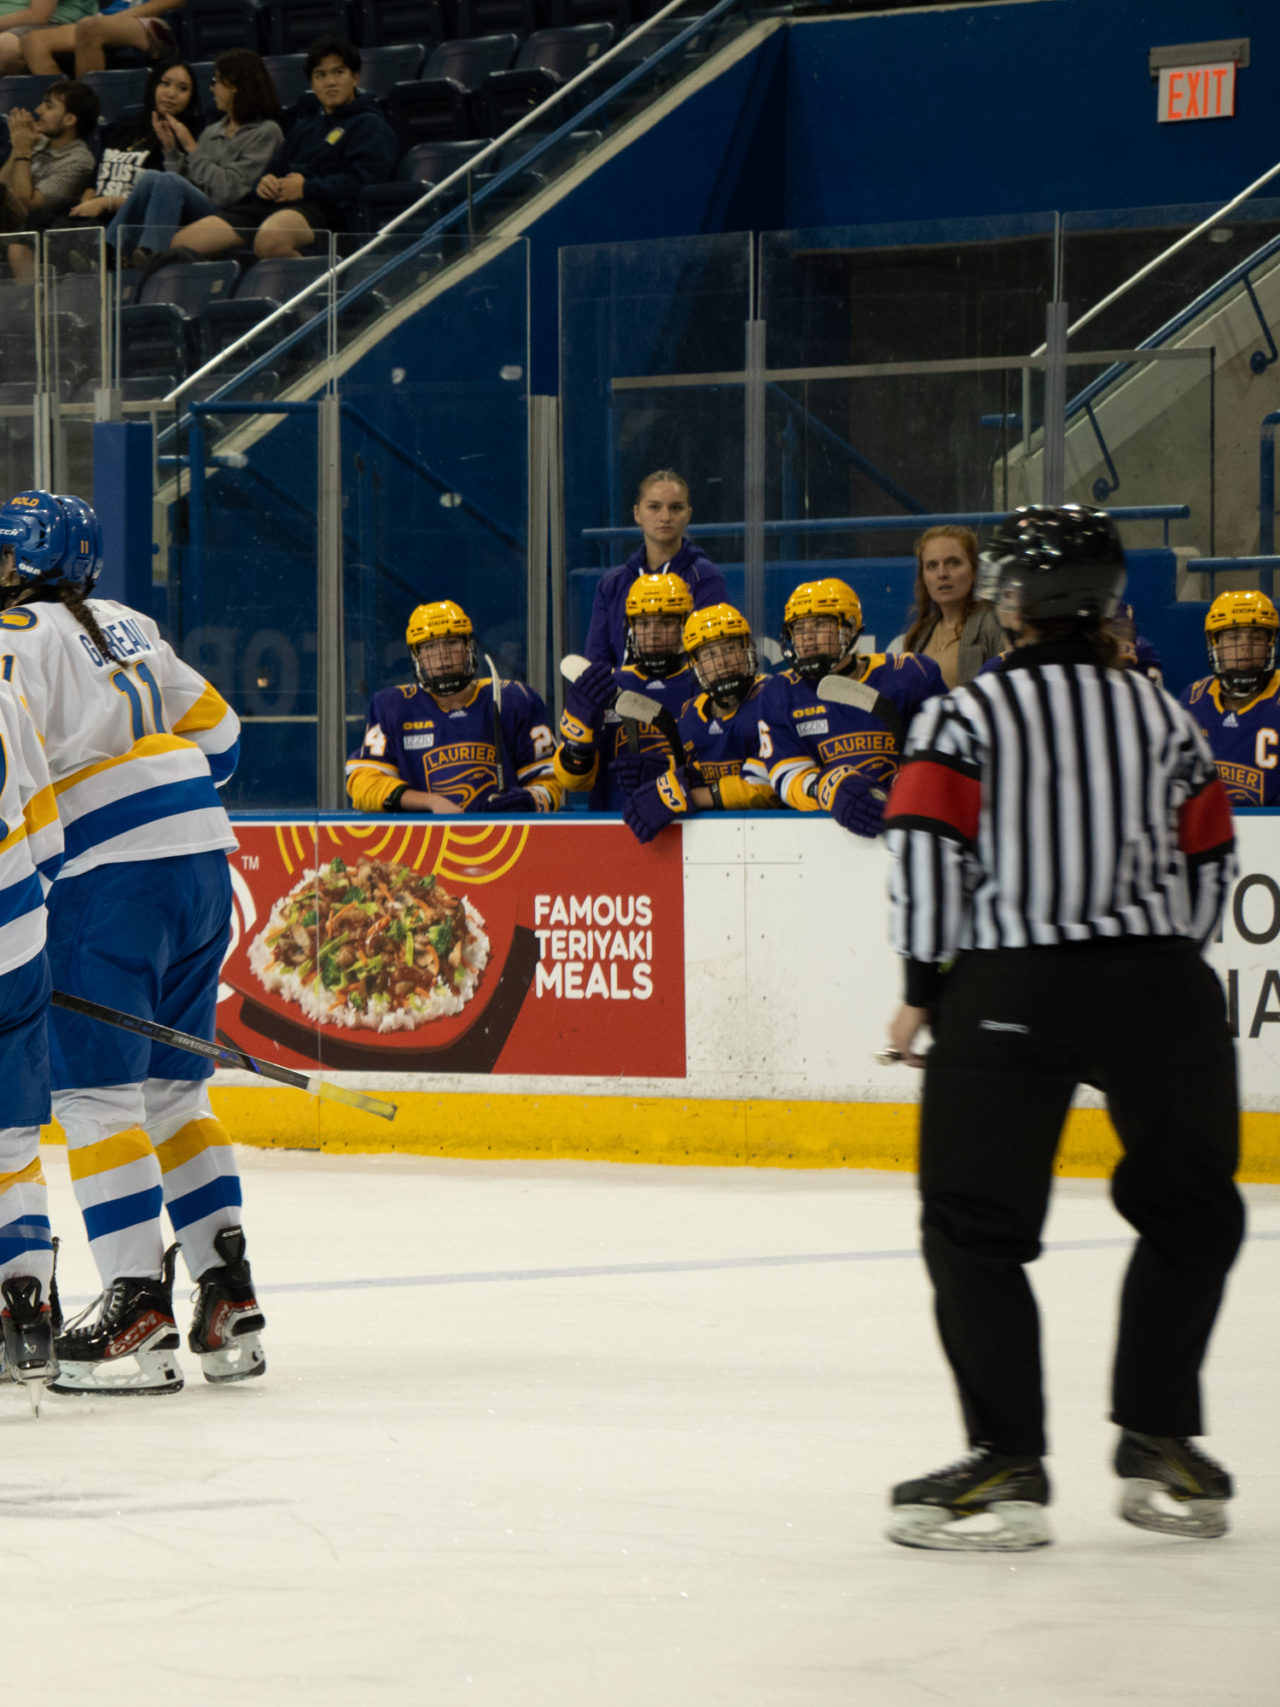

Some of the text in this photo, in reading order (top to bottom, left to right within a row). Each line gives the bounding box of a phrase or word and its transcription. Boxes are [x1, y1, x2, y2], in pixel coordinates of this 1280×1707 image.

[1167, 68, 1227, 119] EXIT
[79, 540, 90, 555] 11
[79, 617, 152, 668] GREAU
[109, 659, 168, 742] 11
[792, 705, 827, 720] OUA
[364, 724, 388, 757] 4
[402, 721, 435, 731] OUA
[427, 747, 497, 769] LAURIER
[822, 736, 897, 758] LAURIER
[1255, 727, 1279, 769] C
[1220, 766, 1258, 788] RIER
[241, 856, 260, 870] TM
[534, 894, 653, 927] FAMOUS
[534, 929, 653, 961] TERIYAKI
[535, 961, 654, 1000] MEALS
[109, 1313, 158, 1356] CCM
